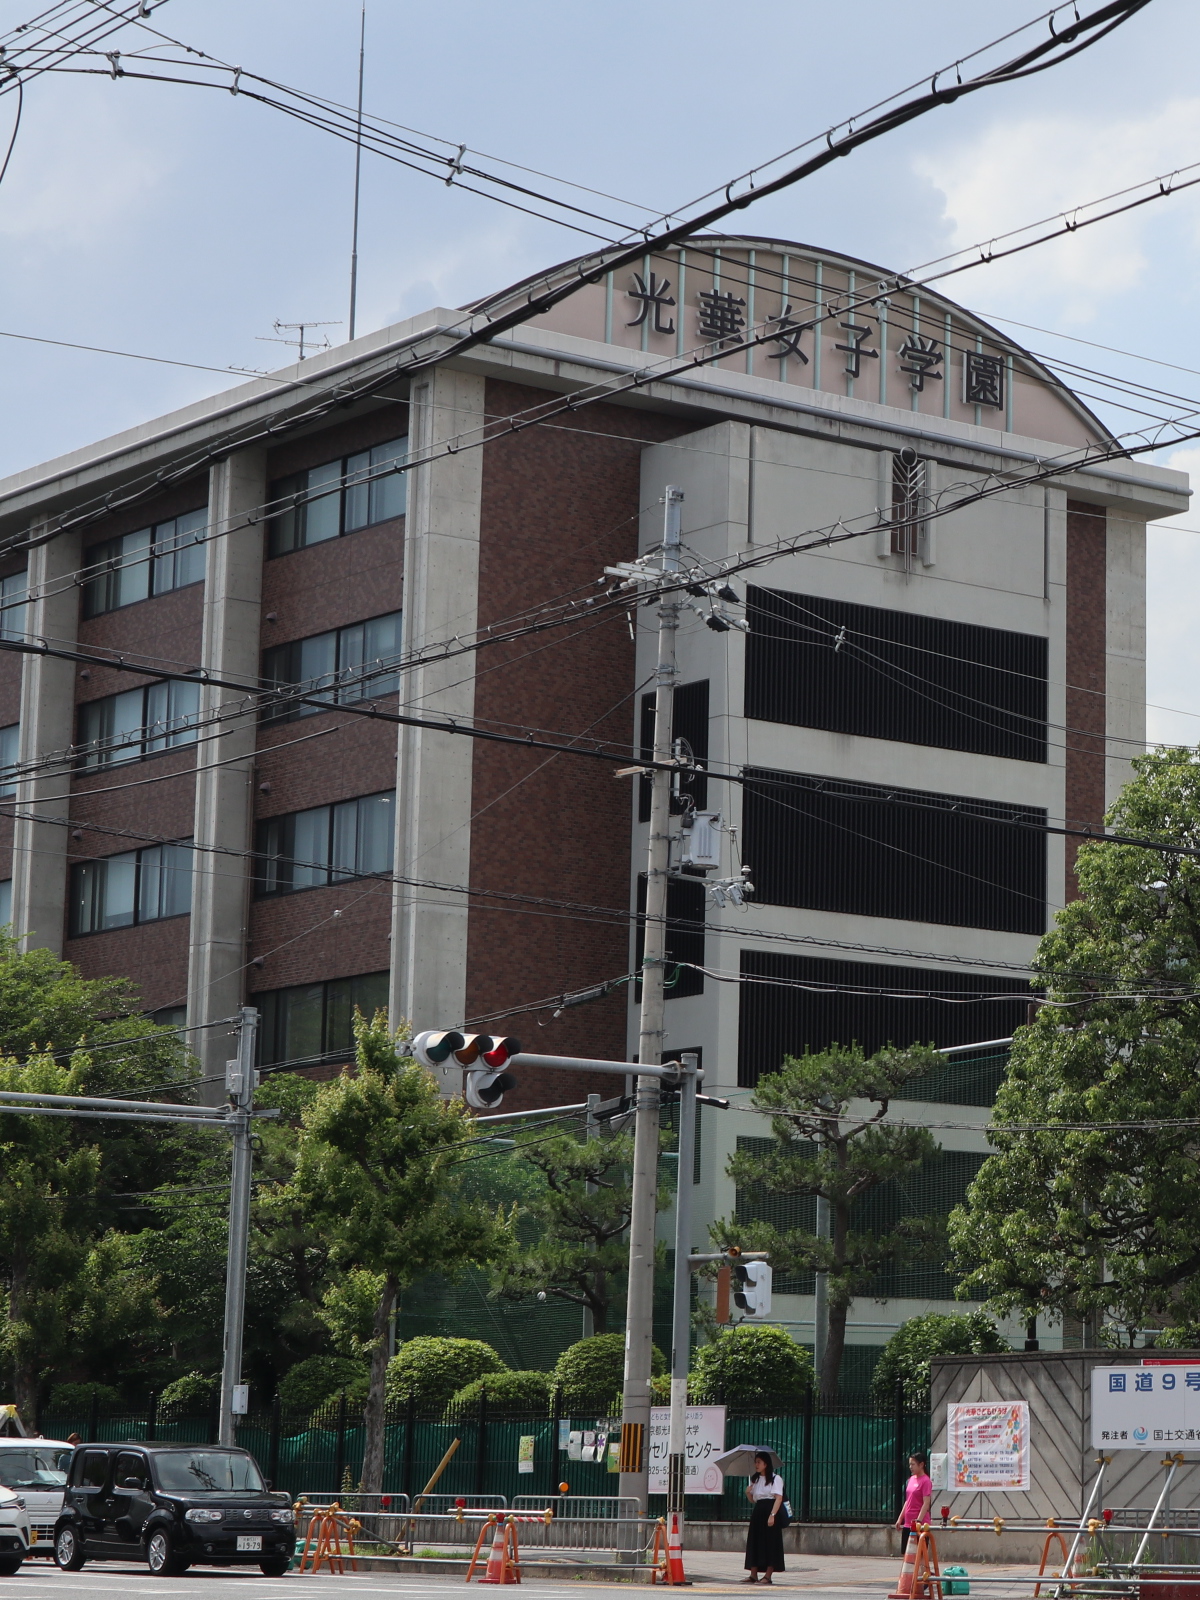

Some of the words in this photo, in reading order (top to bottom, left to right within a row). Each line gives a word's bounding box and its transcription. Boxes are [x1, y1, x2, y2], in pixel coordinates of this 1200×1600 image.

[627, 271, 1004, 411] 光華女子学園
[1101, 1431, 1128, 1440] 発注者
